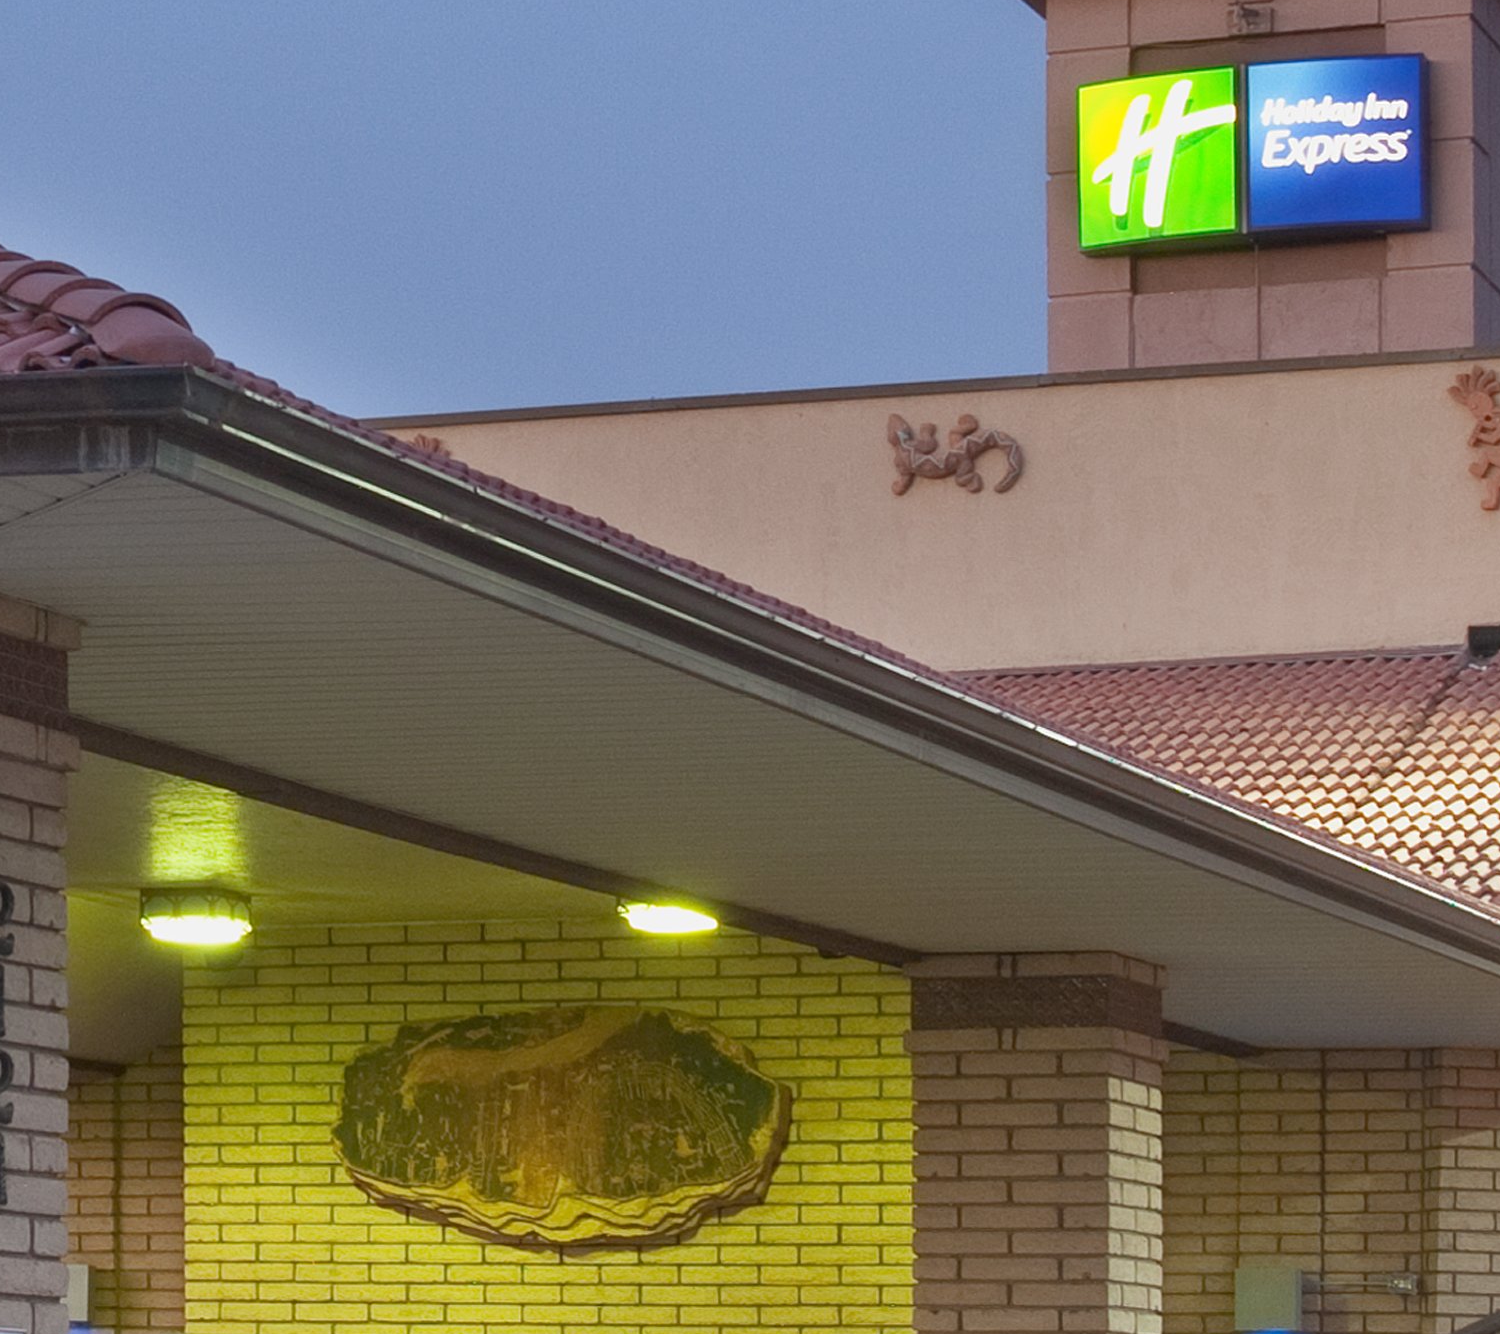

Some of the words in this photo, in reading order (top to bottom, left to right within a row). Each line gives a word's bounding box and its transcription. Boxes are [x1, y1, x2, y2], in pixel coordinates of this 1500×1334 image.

[1260, 94, 1364, 128] Holiday
[1364, 91, 1409, 121] Inn
[1261, 128, 1409, 175] Express
